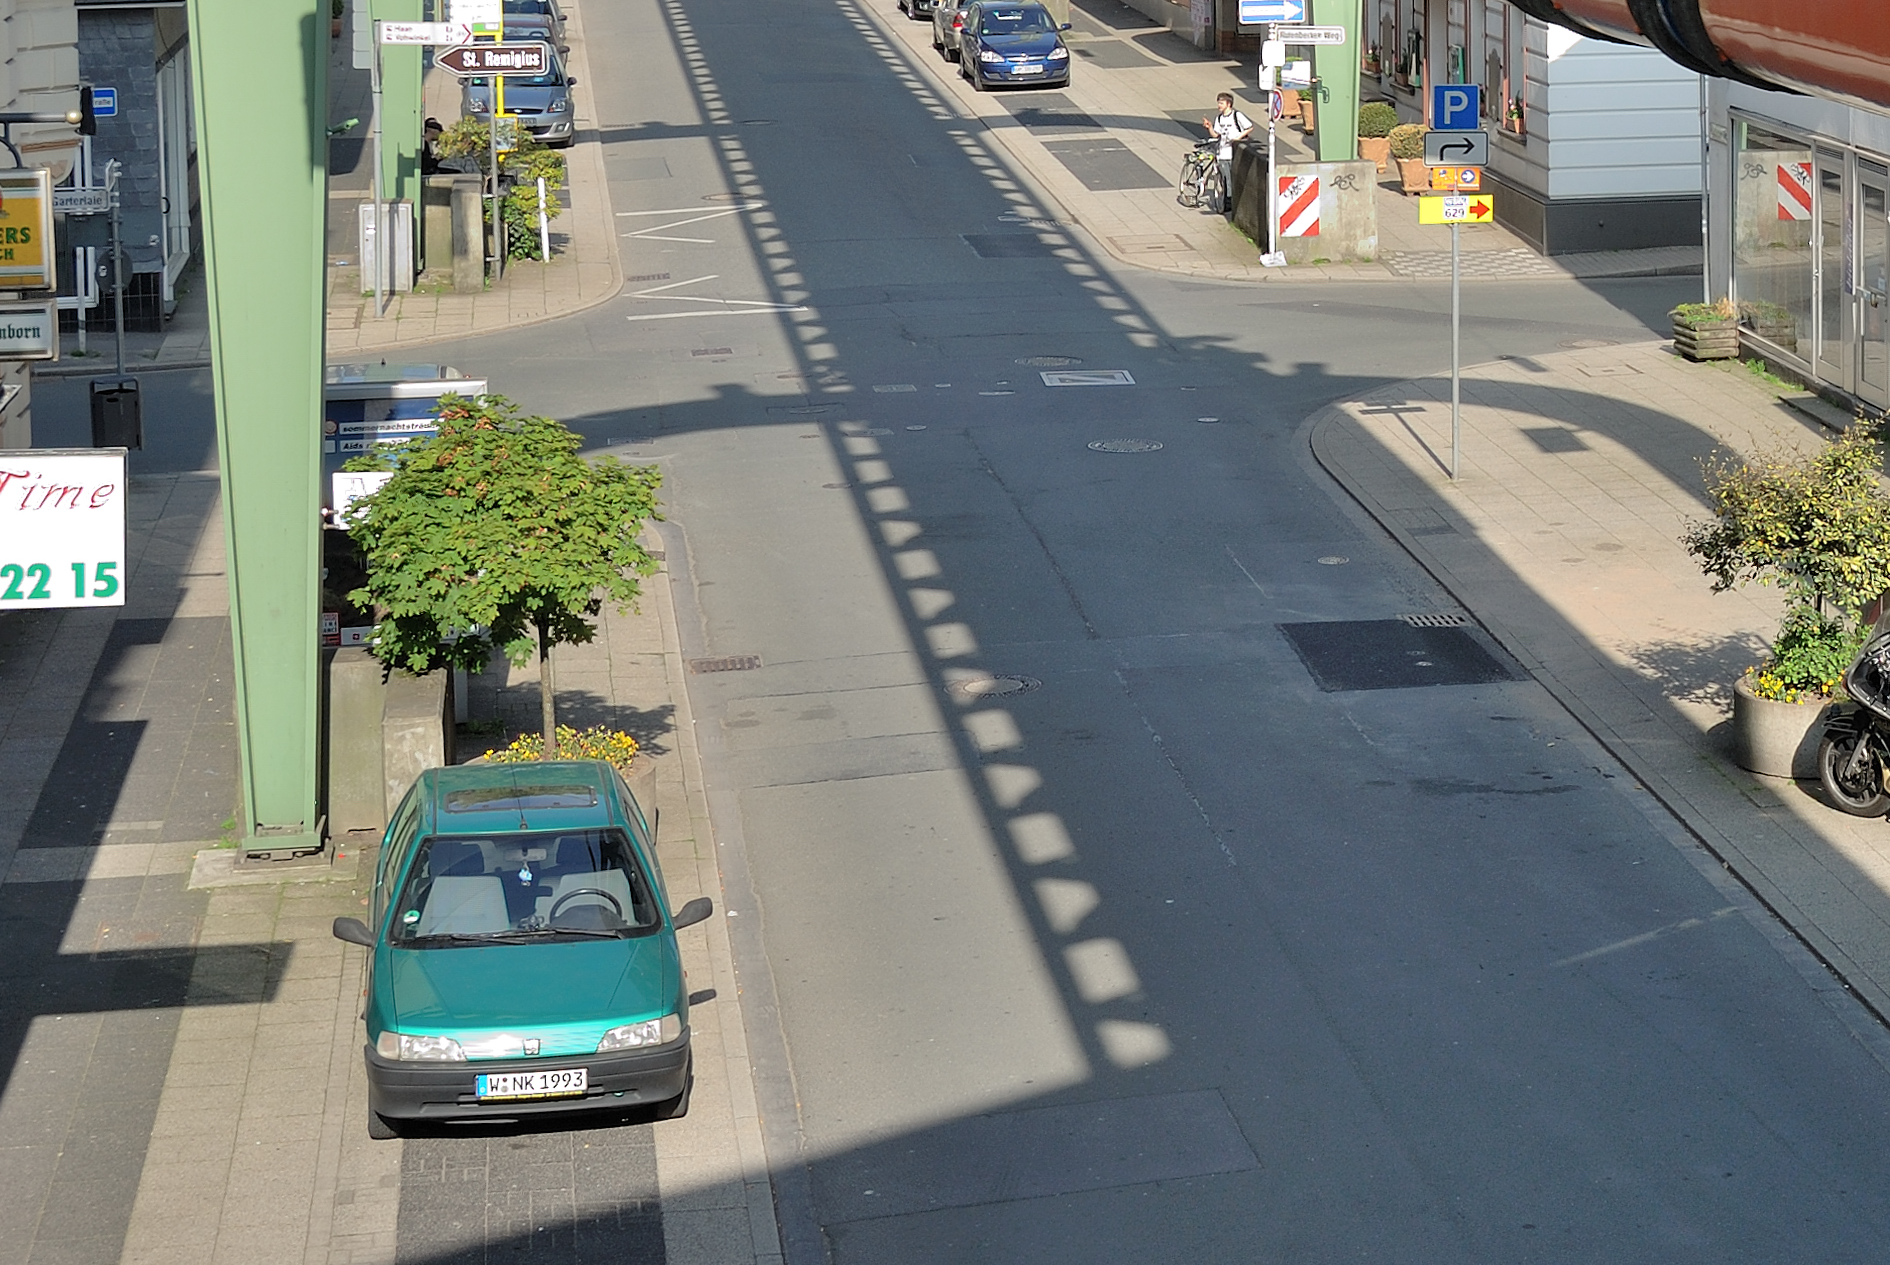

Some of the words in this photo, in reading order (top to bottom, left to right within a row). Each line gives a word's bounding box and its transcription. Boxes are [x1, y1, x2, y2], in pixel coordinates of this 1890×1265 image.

[462, 50, 481, 68] St.
[484, 50, 540, 69] Remigius
[0, 563, 51, 600] 22
[71, 561, 119, 599] 15
[489, 1077, 500, 1092] W
[513, 1075, 535, 1091] NK
[540, 1072, 583, 1090] 1993
